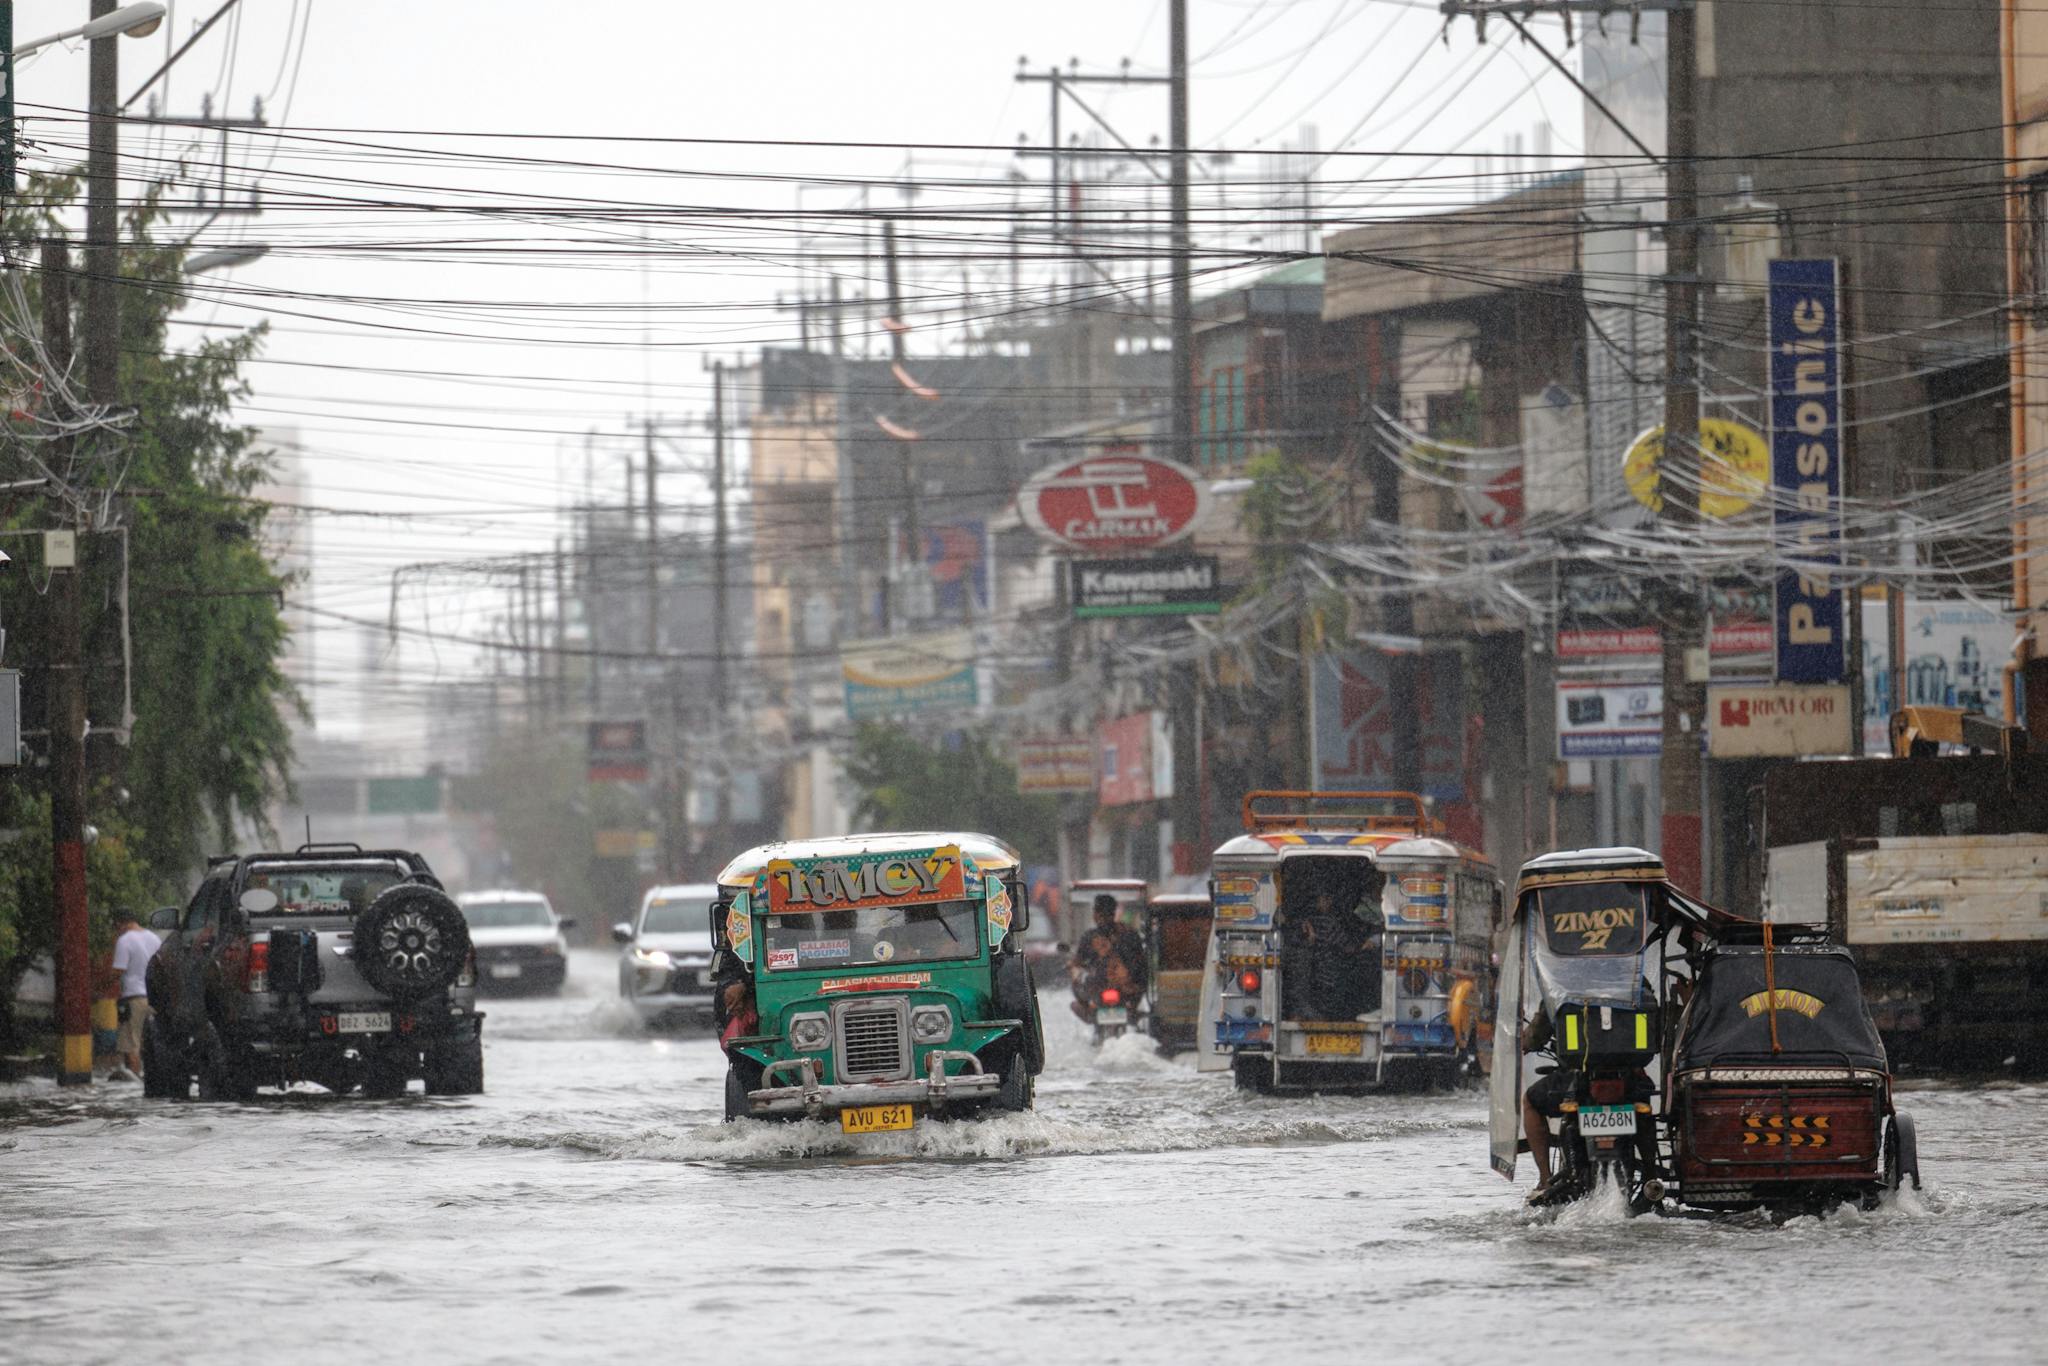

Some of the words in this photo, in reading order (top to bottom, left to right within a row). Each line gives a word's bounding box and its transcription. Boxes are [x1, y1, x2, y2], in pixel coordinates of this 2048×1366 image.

[1783, 298, 1832, 644] Panasonic
[1082, 564, 1212, 593] Kawasaki
[1553, 907, 1635, 933] ZIMON
[800, 940, 849, 951] CALASIAO
[800, 948, 849, 959] DAGUPAN
[849, 1111, 873, 1127] AVU
[882, 1109, 906, 1124] 621
[1583, 1111, 1633, 1129] A6268N
